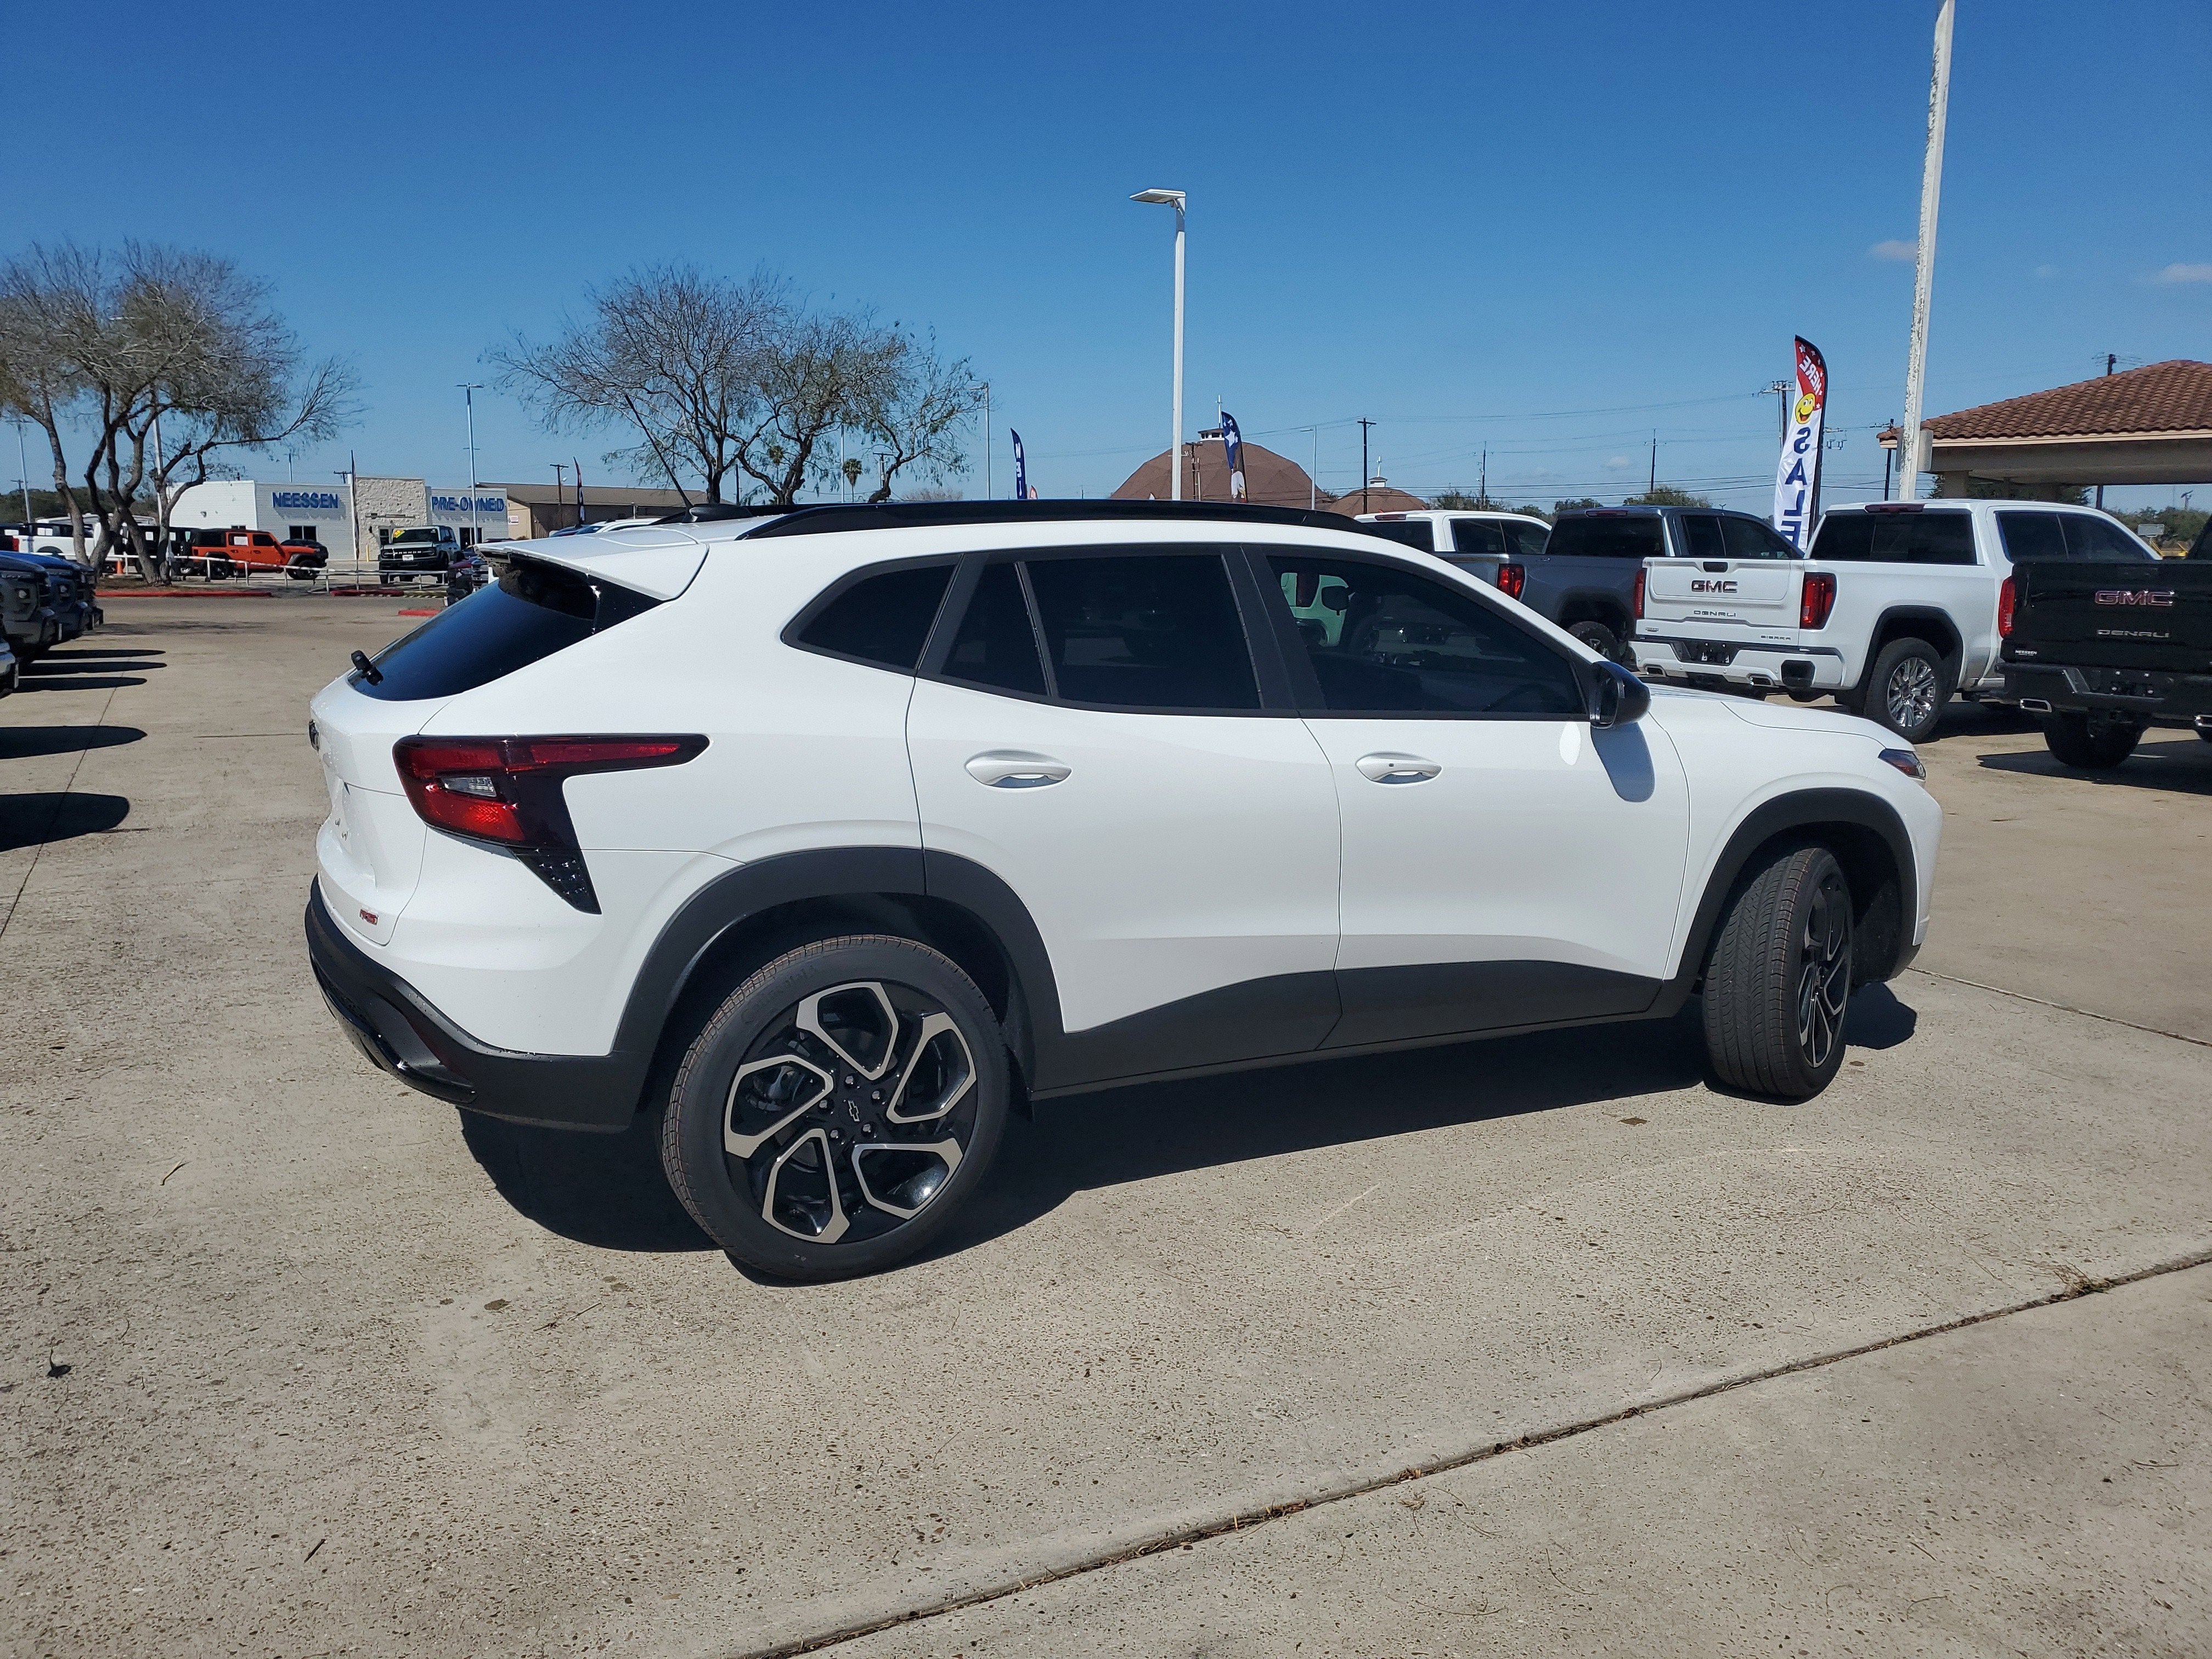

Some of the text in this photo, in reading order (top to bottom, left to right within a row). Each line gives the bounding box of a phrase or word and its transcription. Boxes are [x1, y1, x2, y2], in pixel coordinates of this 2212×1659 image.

[272, 492, 338, 509] NEESSEN
[431, 496, 504, 511] PRE-OWNED
[1691, 580, 1738, 593] GMC
[2095, 590, 2174, 606] GMC
[2097, 629, 2169, 637] DENALI
